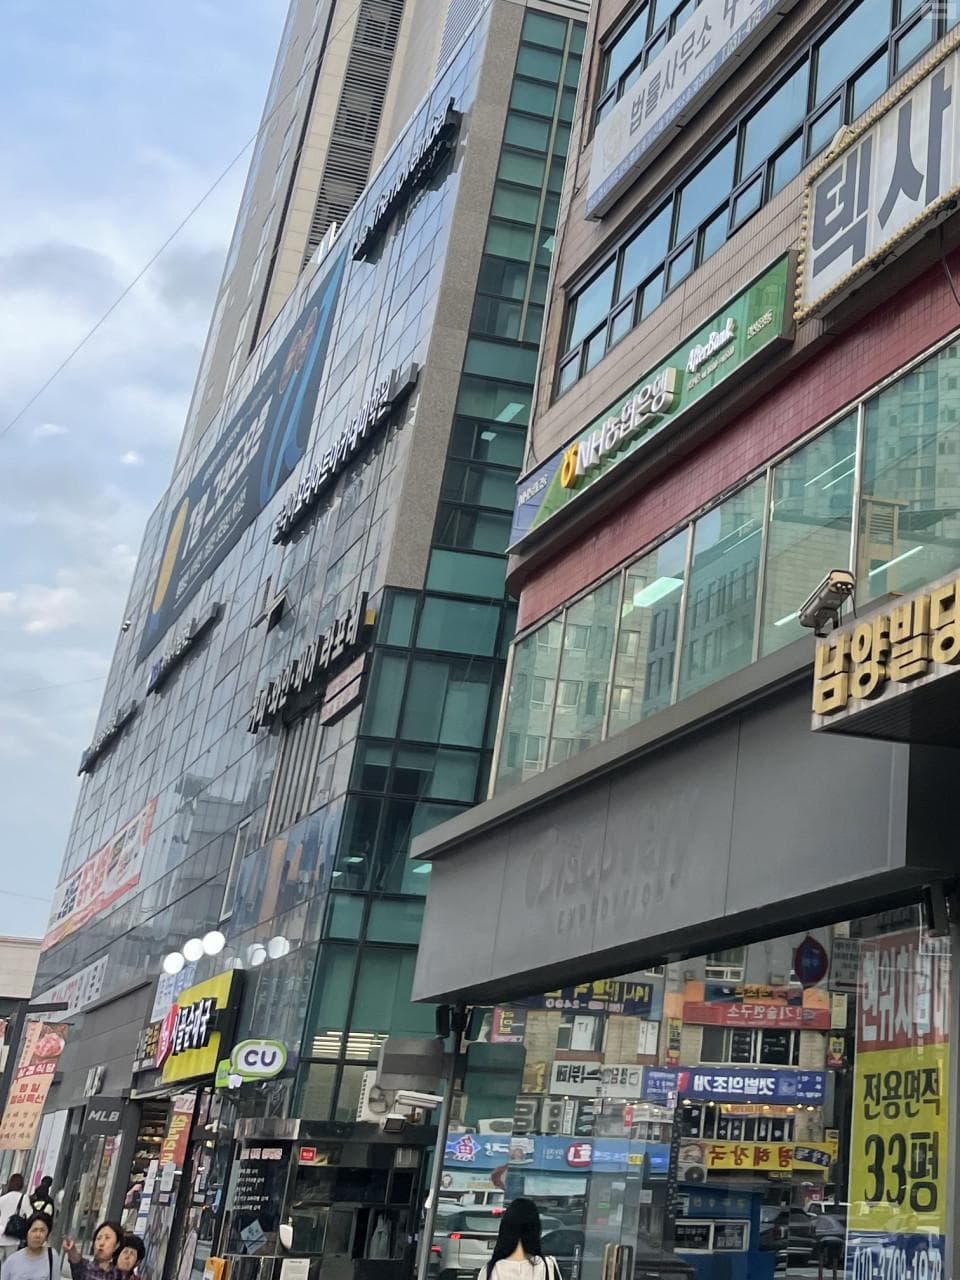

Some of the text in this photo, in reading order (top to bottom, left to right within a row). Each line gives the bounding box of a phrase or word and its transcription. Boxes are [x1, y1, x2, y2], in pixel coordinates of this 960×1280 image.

[629, 16, 713, 137] 법률사무소
[576, 367, 676, 476] NH농협은행
[243, 1048, 278, 1068] CU
[88, 1109, 121, 1123] MLB
[862, 1067, 942, 1121] 전용면적
[863, 1131, 940, 1213] 33평
